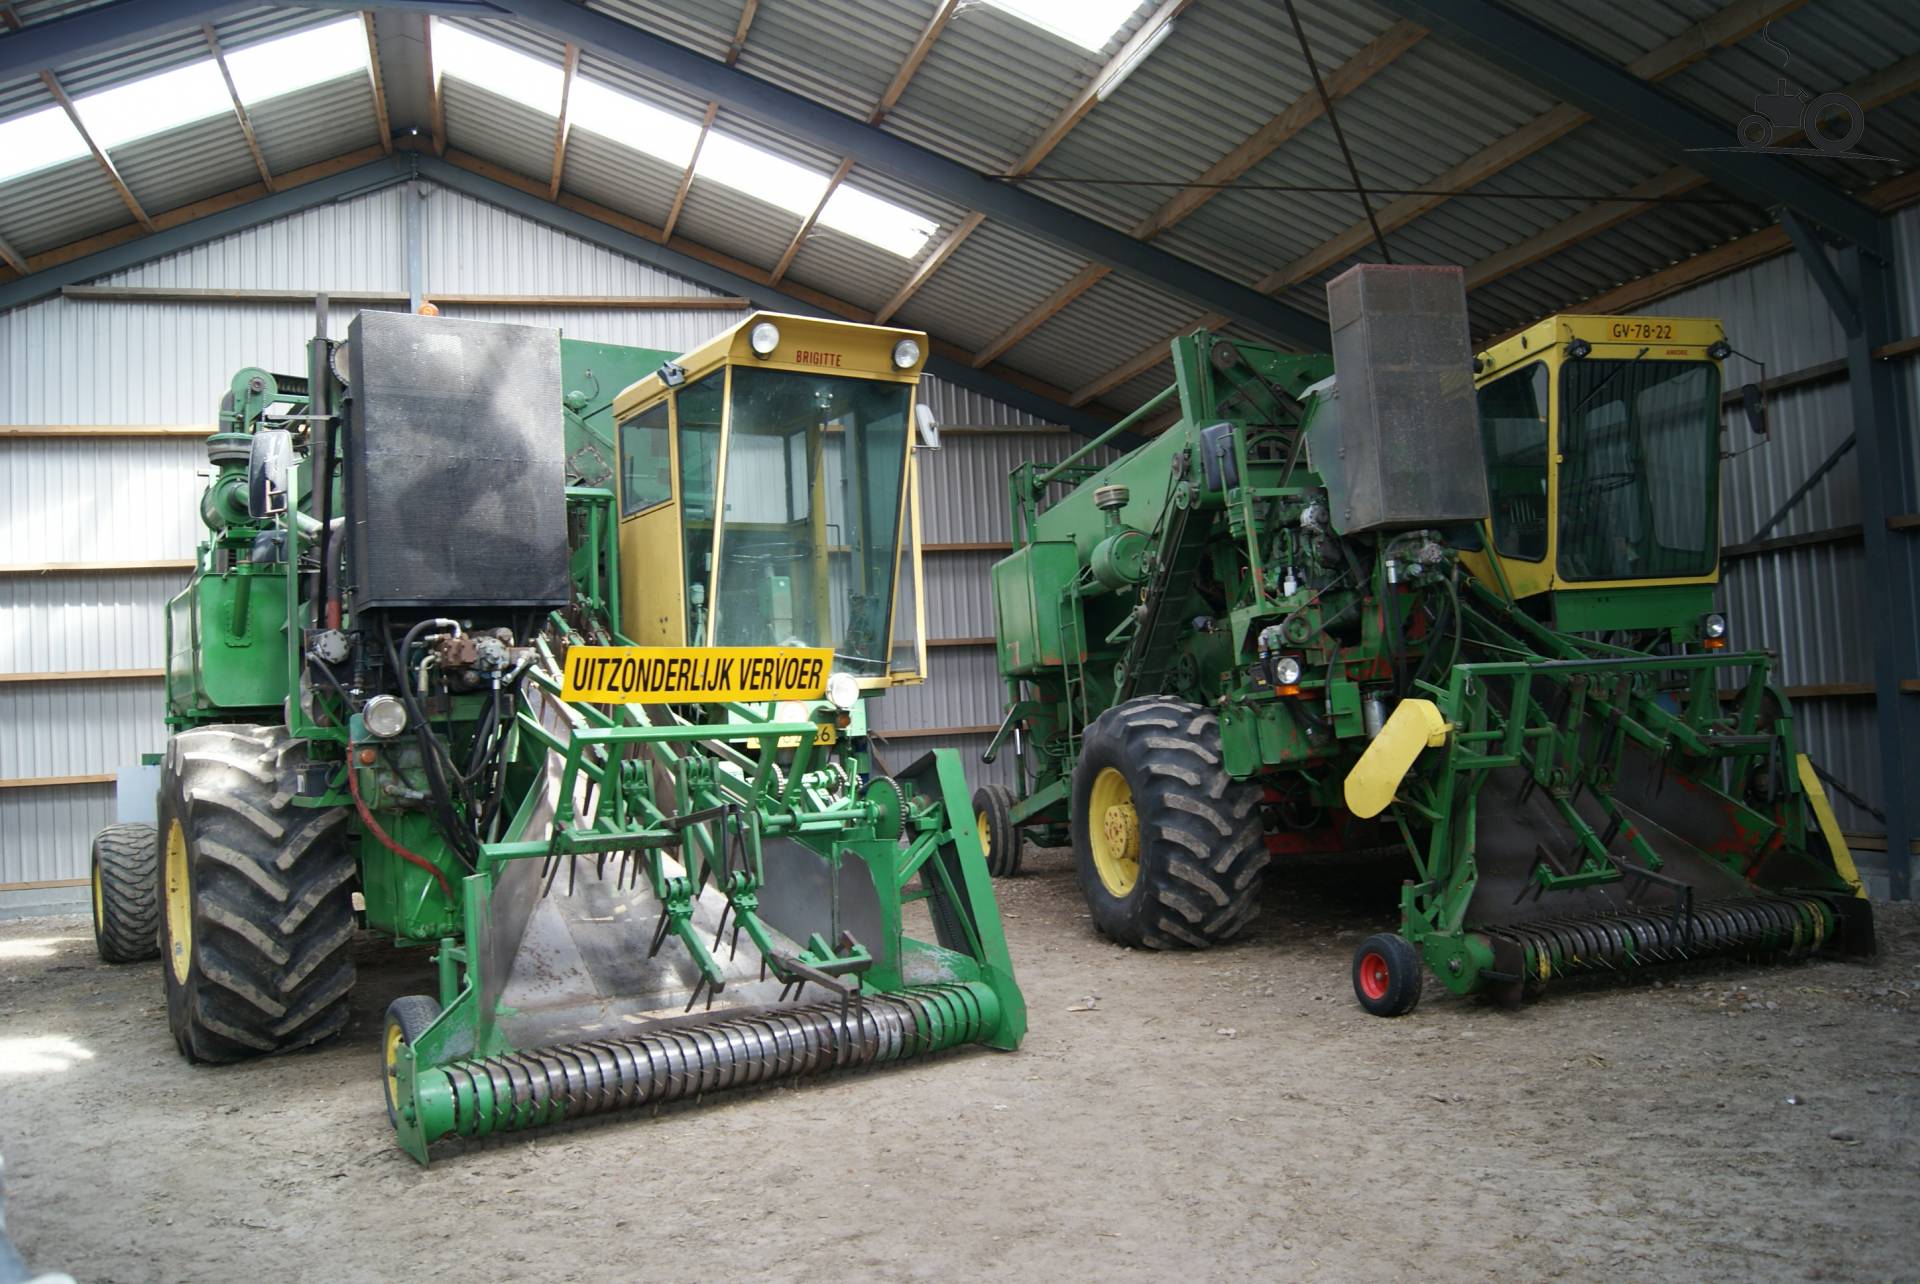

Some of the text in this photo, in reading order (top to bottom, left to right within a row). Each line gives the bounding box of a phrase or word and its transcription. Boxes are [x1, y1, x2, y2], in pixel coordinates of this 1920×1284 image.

[1613, 323, 1672, 340] GV-78-22
[796, 350, 842, 367] BRIGITTE
[573, 657, 823, 692] UITZONDERLIJK VERVOER
